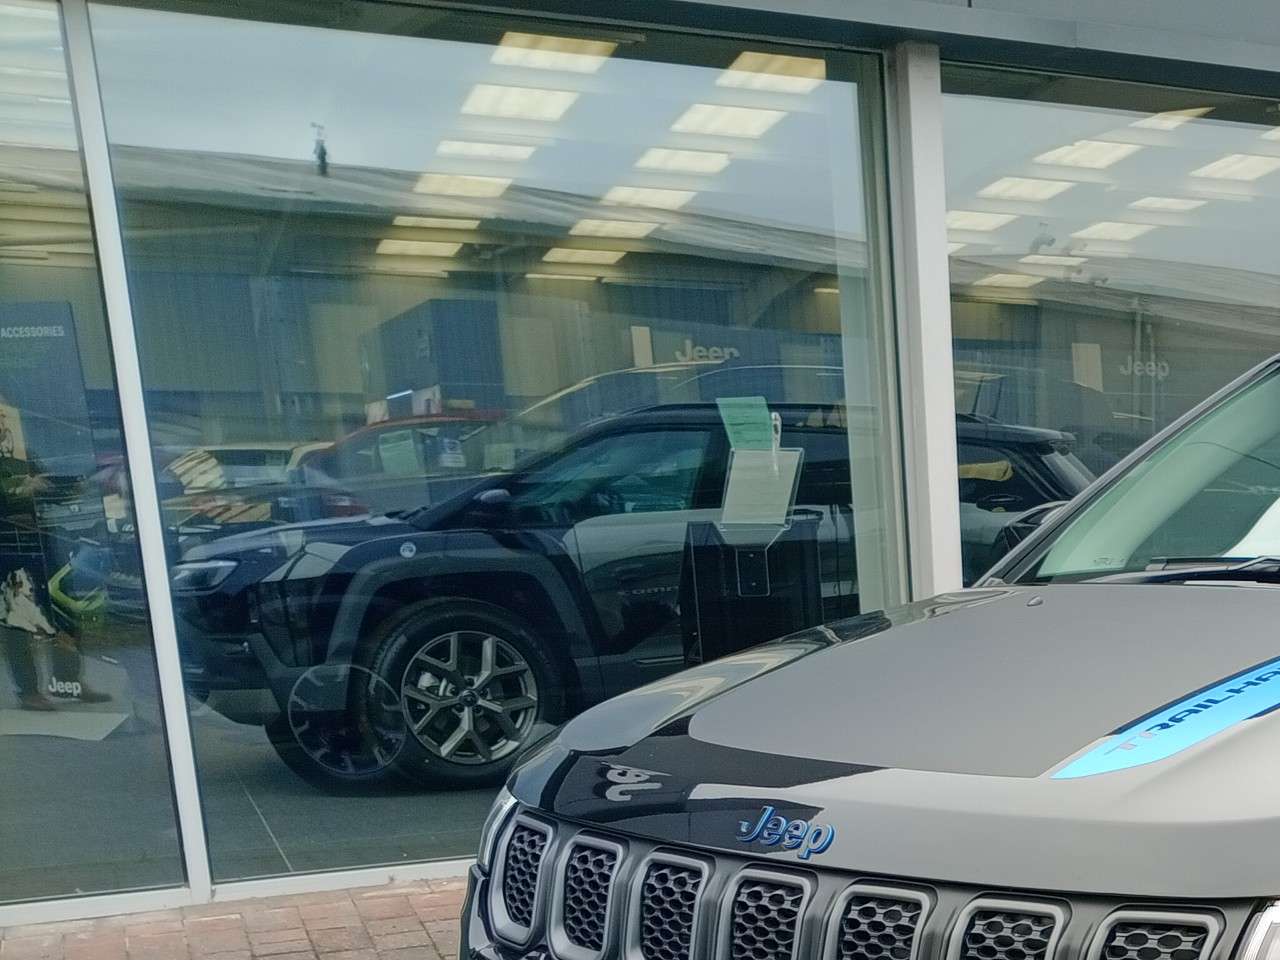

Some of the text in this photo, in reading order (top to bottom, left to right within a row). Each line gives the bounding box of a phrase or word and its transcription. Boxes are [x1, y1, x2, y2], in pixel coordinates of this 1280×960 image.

[1119, 354, 1170, 382] Jeep
[48, 676, 82, 697] Jeep
[735, 805, 836, 861] Jeep
